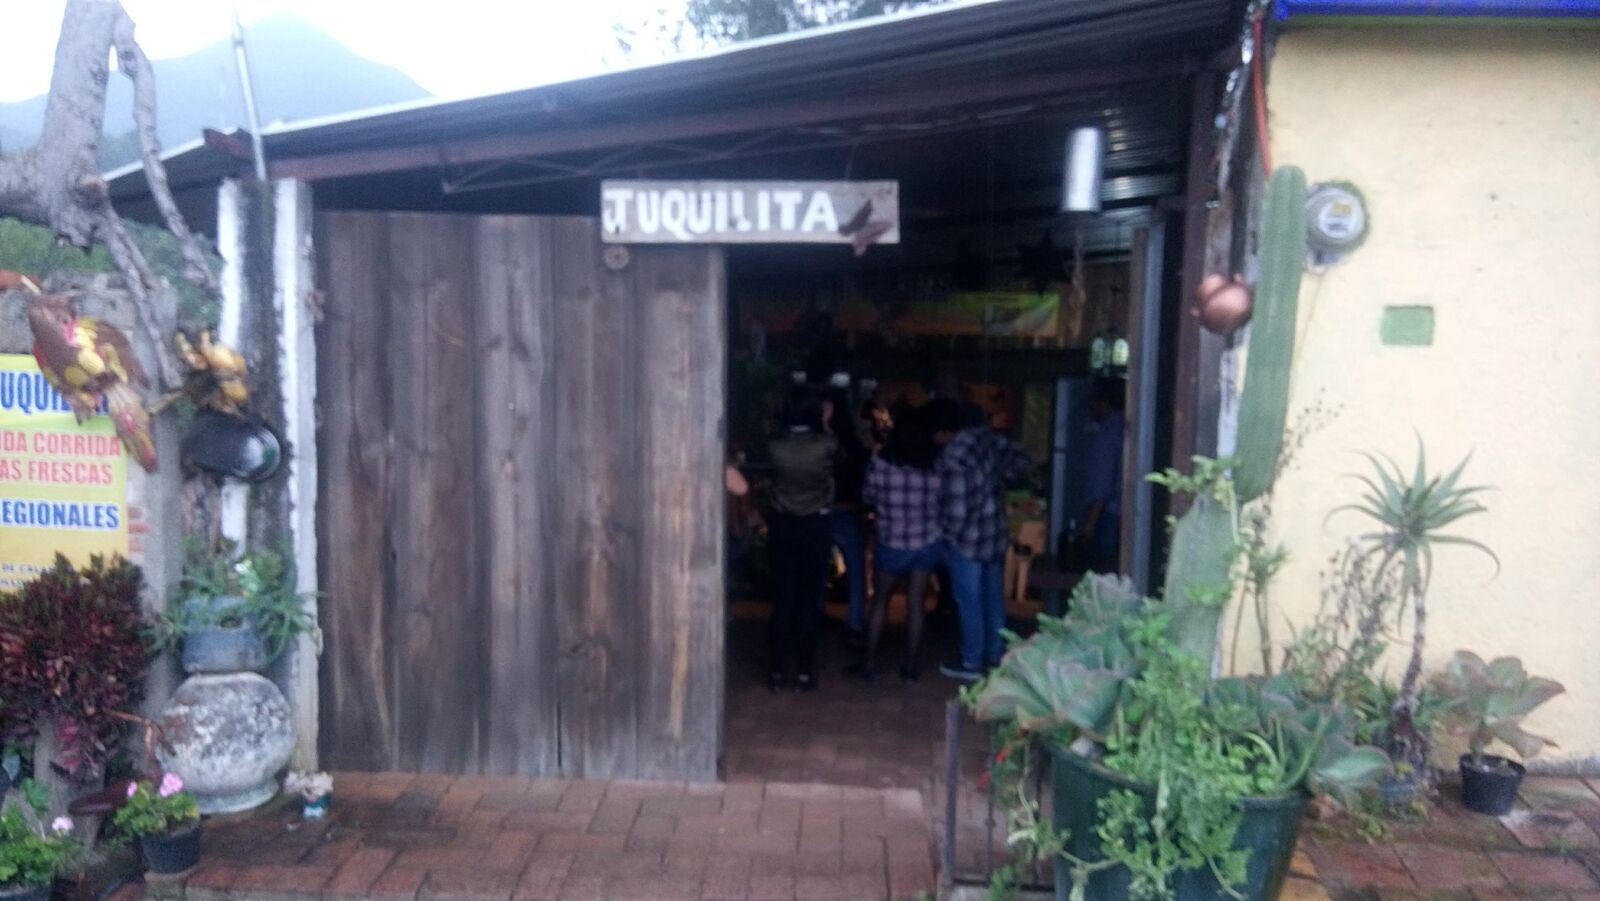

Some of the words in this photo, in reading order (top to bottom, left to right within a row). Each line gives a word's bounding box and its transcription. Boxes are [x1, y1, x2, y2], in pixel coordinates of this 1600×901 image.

[33, 432, 121, 456] CORRIDA
[28, 461, 113, 485] FRESCAS
[2, 500, 120, 528] EGIONALES
